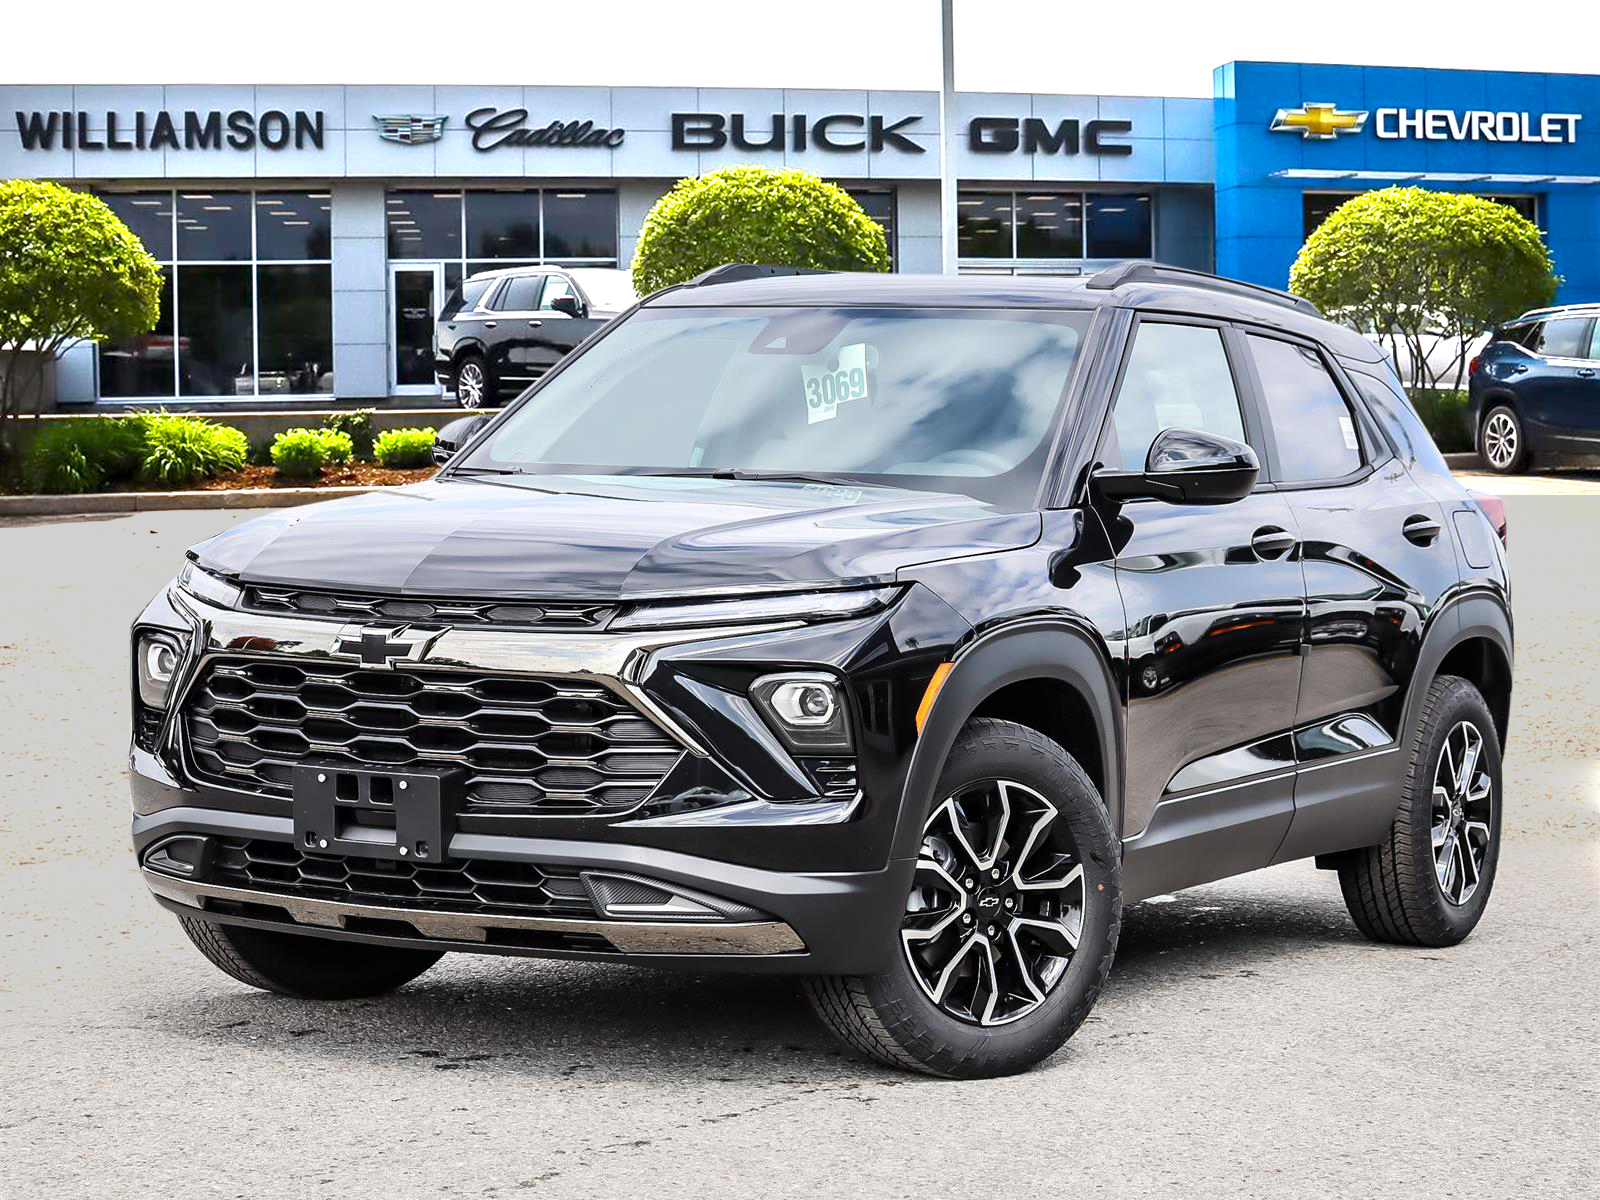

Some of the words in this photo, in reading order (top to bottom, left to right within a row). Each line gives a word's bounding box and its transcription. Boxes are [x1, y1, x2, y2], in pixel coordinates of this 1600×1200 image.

[15, 110, 325, 151] WILLIAMSON
[465, 107, 624, 152] Cadillac
[671, 112, 927, 153] BUICK
[969, 116, 1133, 156] GMC
[1376, 108, 1582, 143] CHEVROLET
[806, 367, 865, 408] 3069
